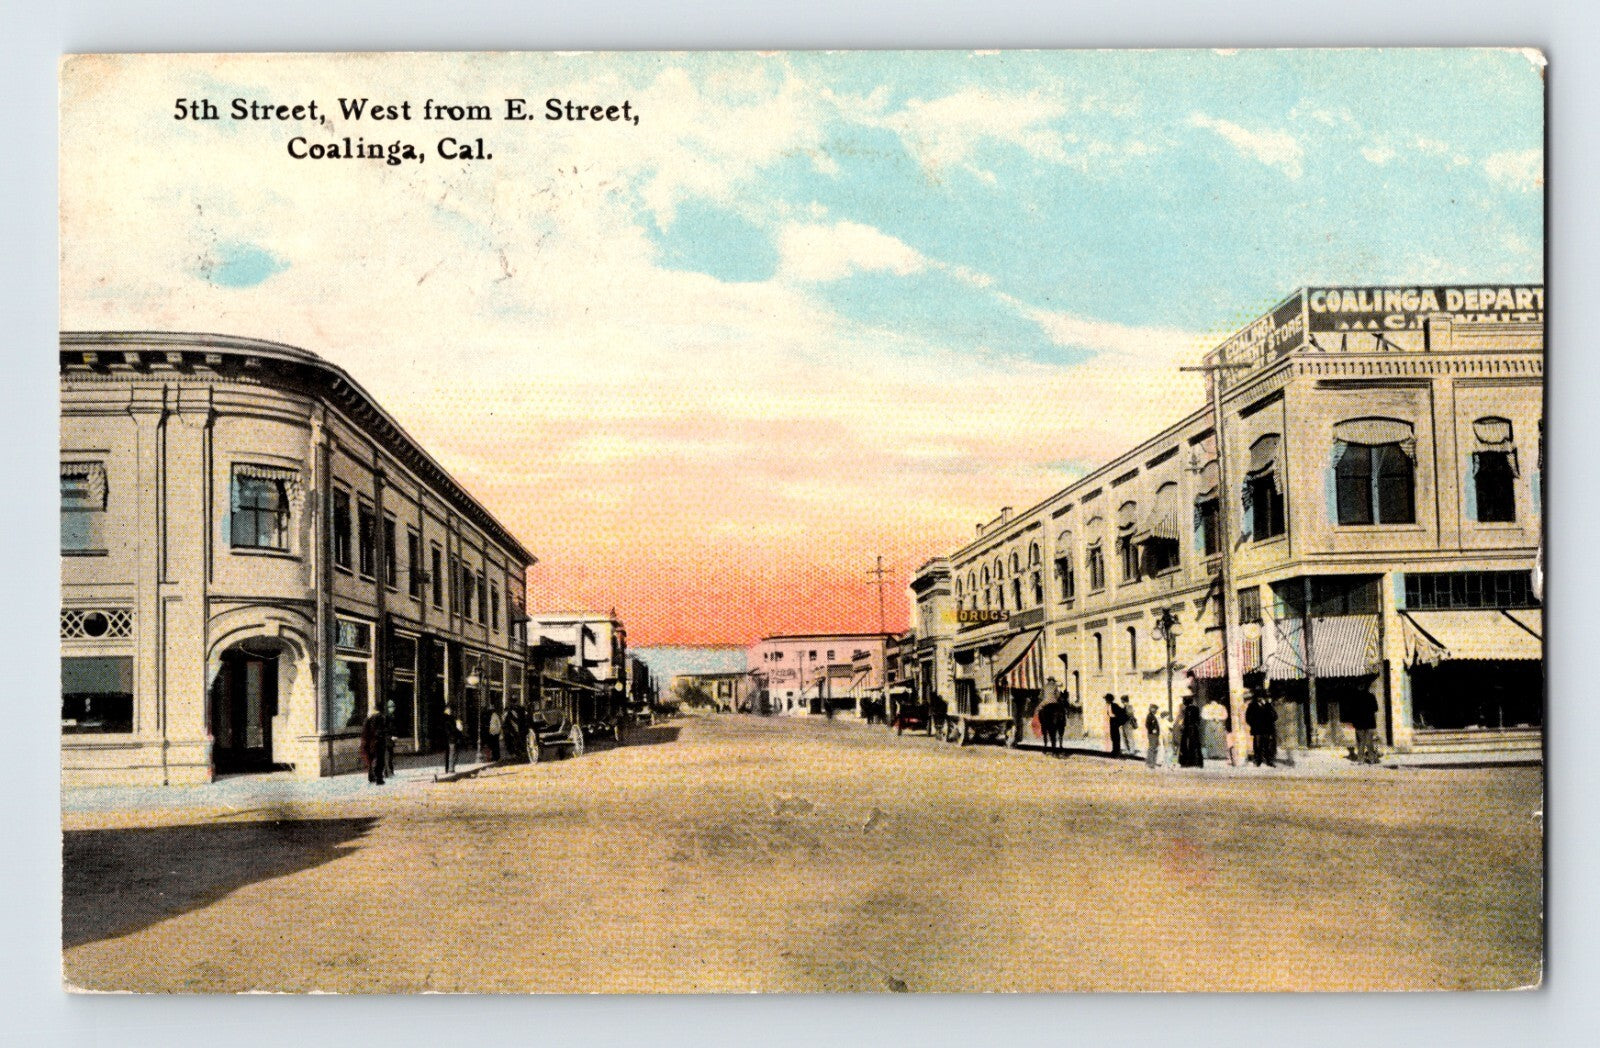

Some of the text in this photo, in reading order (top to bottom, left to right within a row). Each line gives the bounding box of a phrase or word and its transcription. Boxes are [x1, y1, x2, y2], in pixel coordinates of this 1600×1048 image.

[1310, 288, 1544, 313] COALINGA DEPART
[959, 610, 1009, 621] DRUGS
